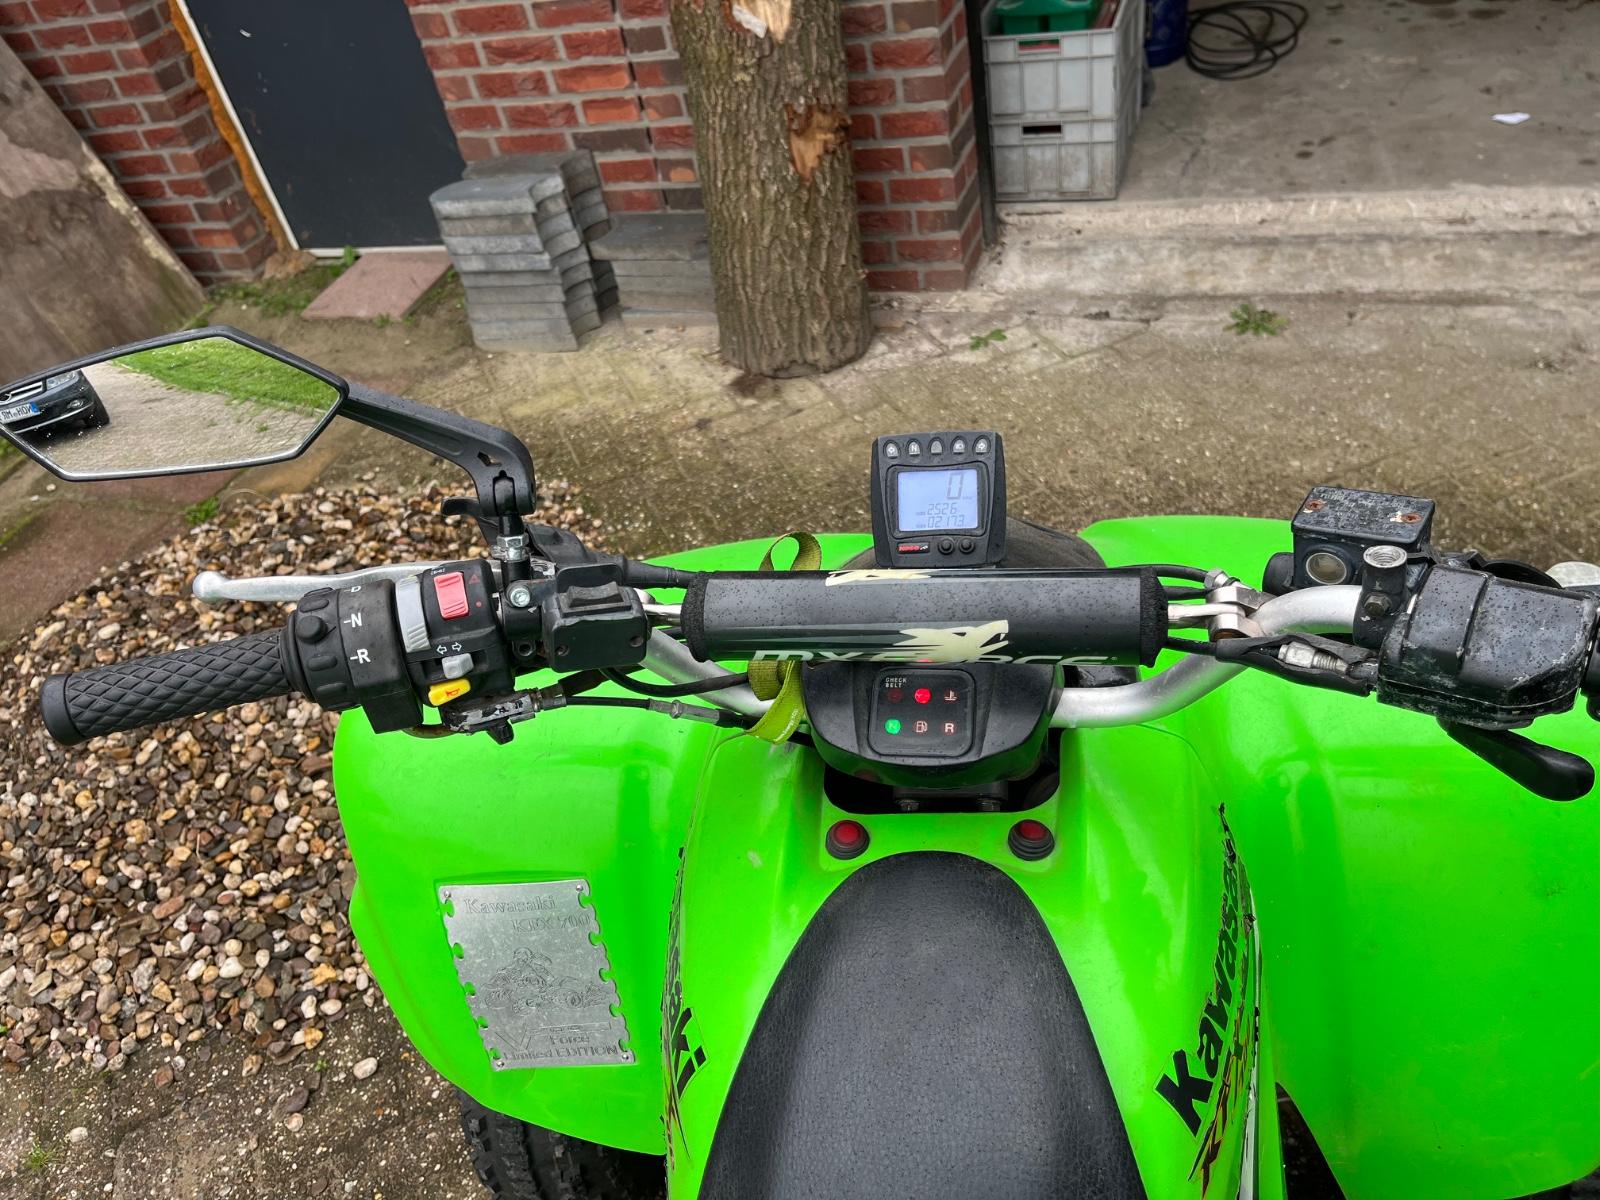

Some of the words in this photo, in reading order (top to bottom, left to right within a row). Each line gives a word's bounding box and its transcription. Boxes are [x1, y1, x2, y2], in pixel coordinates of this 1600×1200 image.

[947, 472, 964, 499] 0
[927, 502, 957, 515] 2526
[351, 612, 362, 628] N
[357, 648, 371, 664] R
[945, 722, 954, 733] R
[464, 895, 557, 914] Kawasaki
[555, 1044, 618, 1058] EDITION
